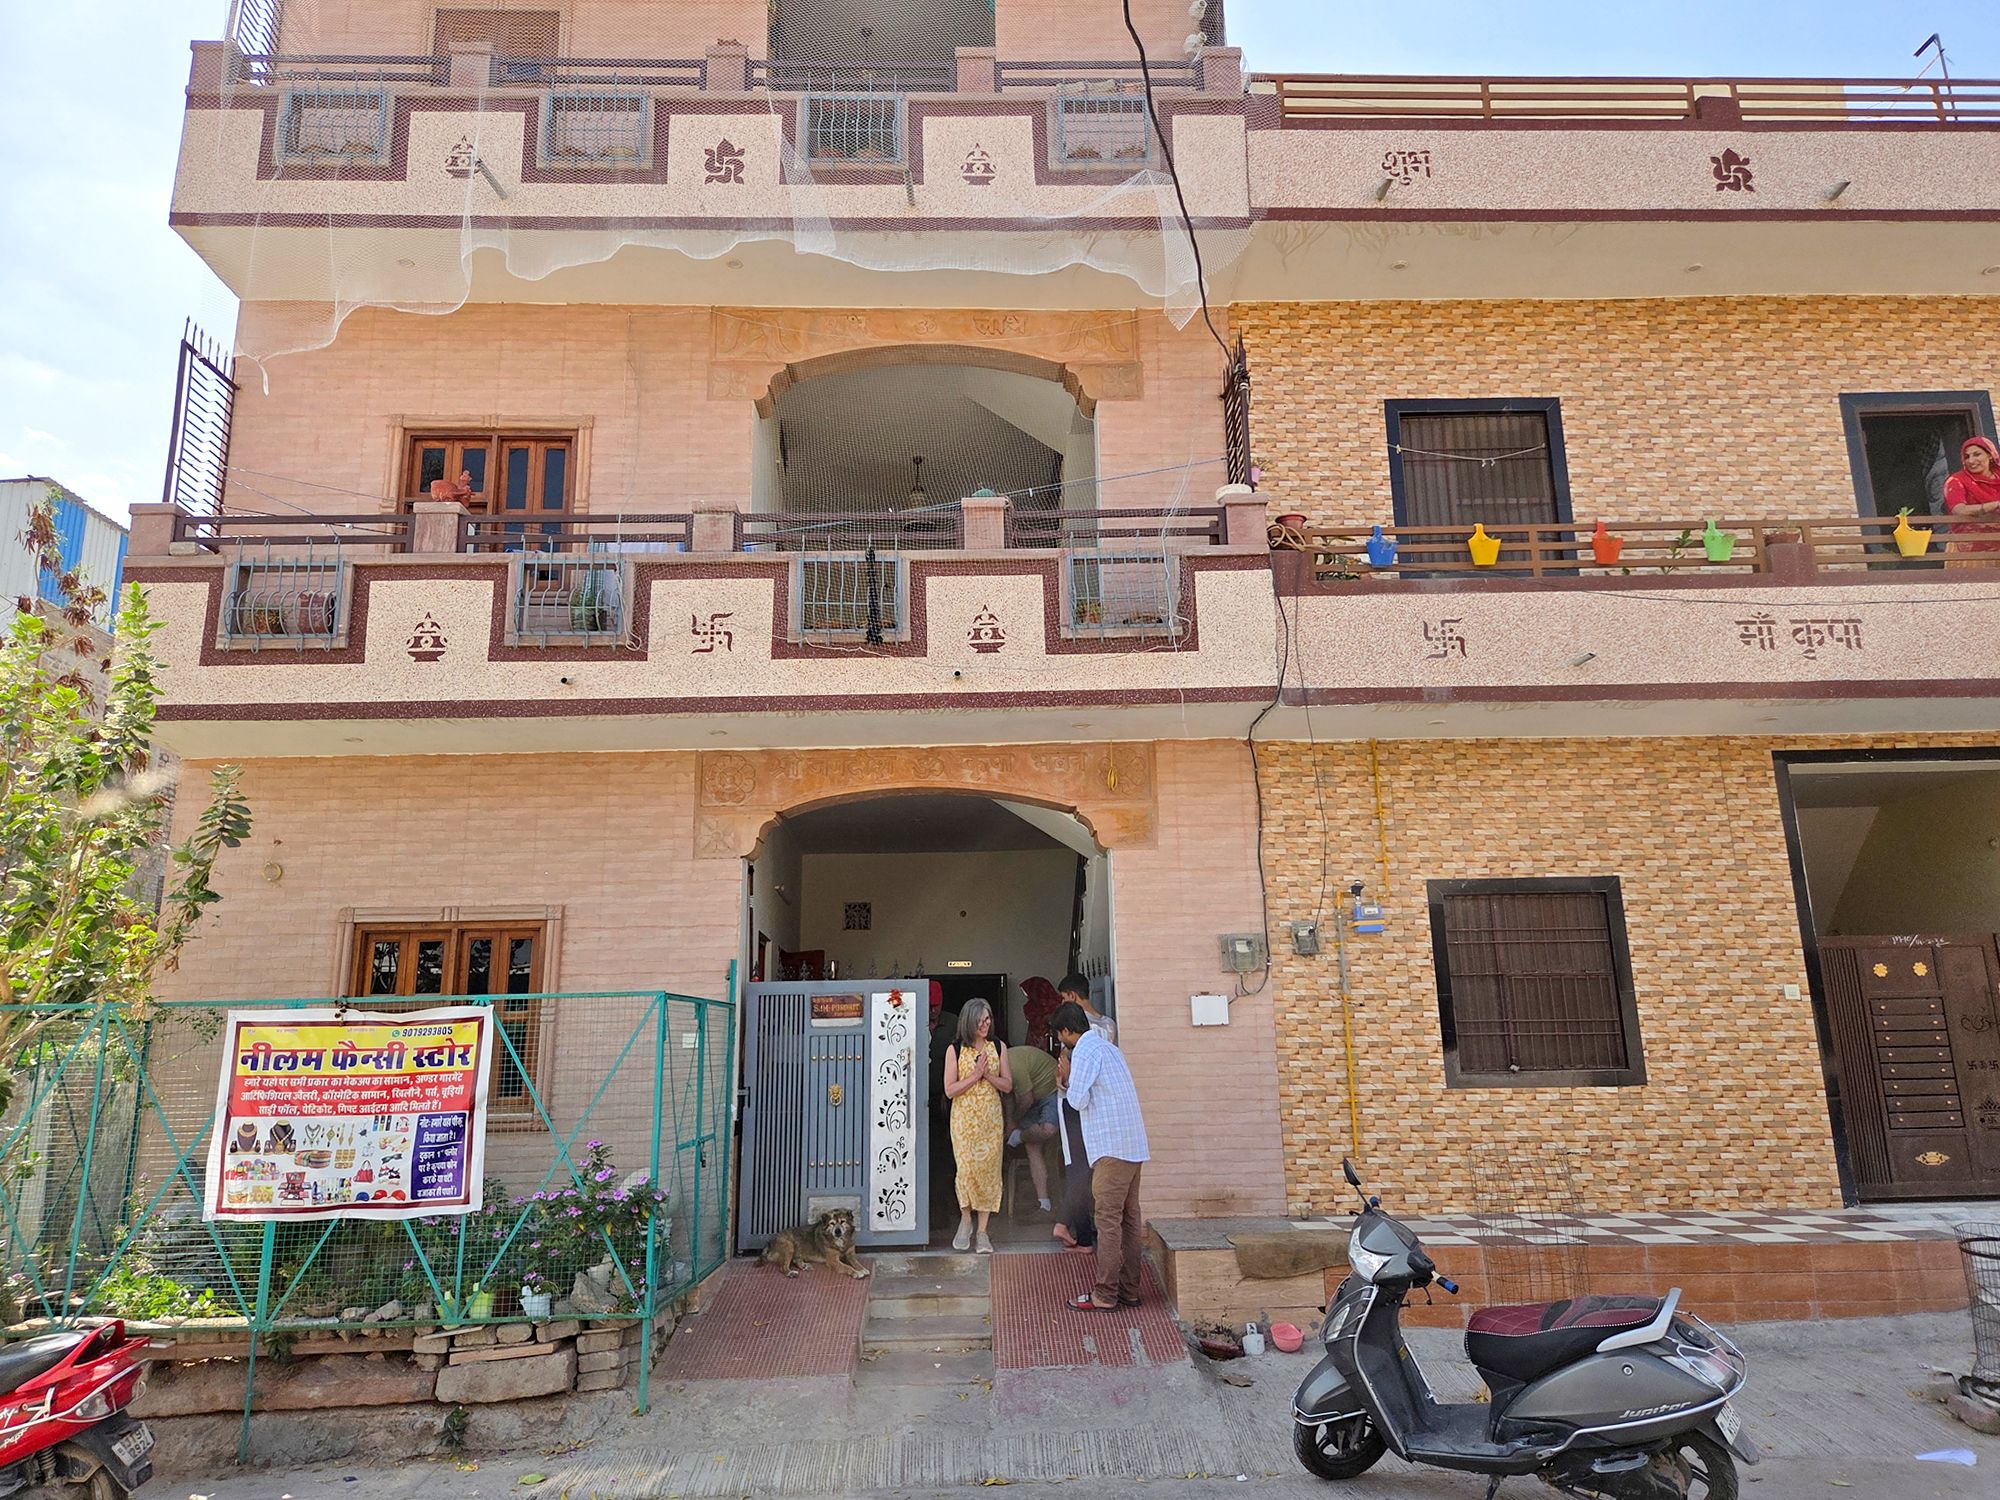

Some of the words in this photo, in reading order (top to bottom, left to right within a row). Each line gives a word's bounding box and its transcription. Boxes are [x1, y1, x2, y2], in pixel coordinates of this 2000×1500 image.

[1381, 149, 1431, 186] शुभ
[1789, 618, 1863, 661] कृपा
[402, 1027, 453, 1037] 9079293805
[240, 1041, 327, 1071] नीलम
[331, 1040, 408, 1070] फैन्सी
[413, 1038, 474, 1068] स्टोर
[244, 1076, 262, 1087] हमारे
[278, 1077, 288, 1087] पर
[289, 1076, 307, 1087] सभी
[307, 1077, 329, 1087] प्रकार
[331, 1077, 342, 1086] का
[371, 1076, 382, 1086] का
[383, 1076, 413, 1086] सामान,
[415, 1074, 437, 1085] अण्डर
[360, 1090, 390, 1100] सामान,
[391, 1086, 423, 1099] खिलौने,
[302, 1103, 336, 1115] पेटिकोट,
[359, 1102, 387, 1114] आईटम
[389, 1101, 409, 1113] आदि
[409, 1101, 430, 1112] मिलते
[1619, 1401, 1692, 1419] Jupiter
